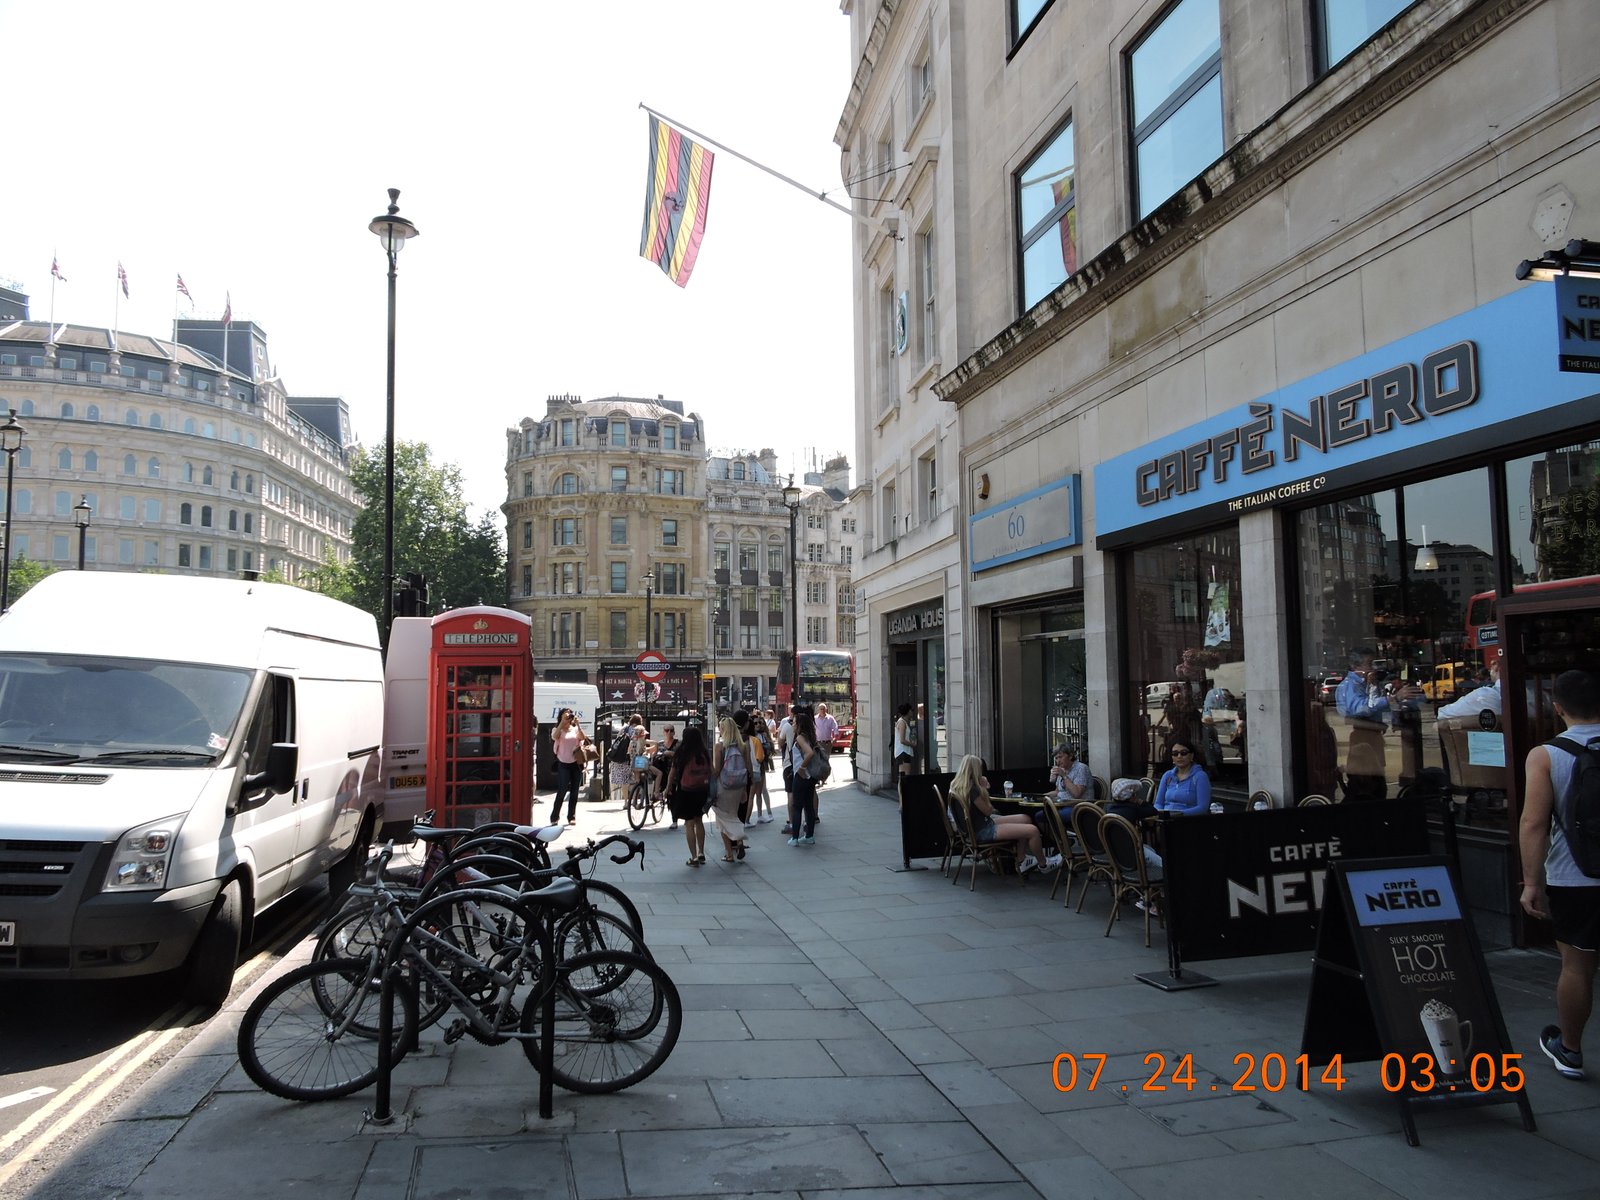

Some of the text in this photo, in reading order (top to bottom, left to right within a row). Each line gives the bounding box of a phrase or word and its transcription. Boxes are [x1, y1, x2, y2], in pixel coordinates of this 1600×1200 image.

[1281, 340, 1481, 462] NERO
[1228, 500, 1243, 512] THE
[1244, 490, 1277, 508] ITALIAN
[1278, 481, 1311, 499] COFFEE
[1007, 511, 1025, 540] 60
[888, 607, 944, 636] UGANDA HOUS
[447, 633, 516, 644] TELEPHONE
[1227, 869, 1327, 919] NE
[1364, 889, 1442, 912] NERO
[1389, 934, 1445, 944] SILKY SMOOTH
[1392, 943, 1447, 973] HOT
[1400, 970, 1457, 984] CHOCOLATE
